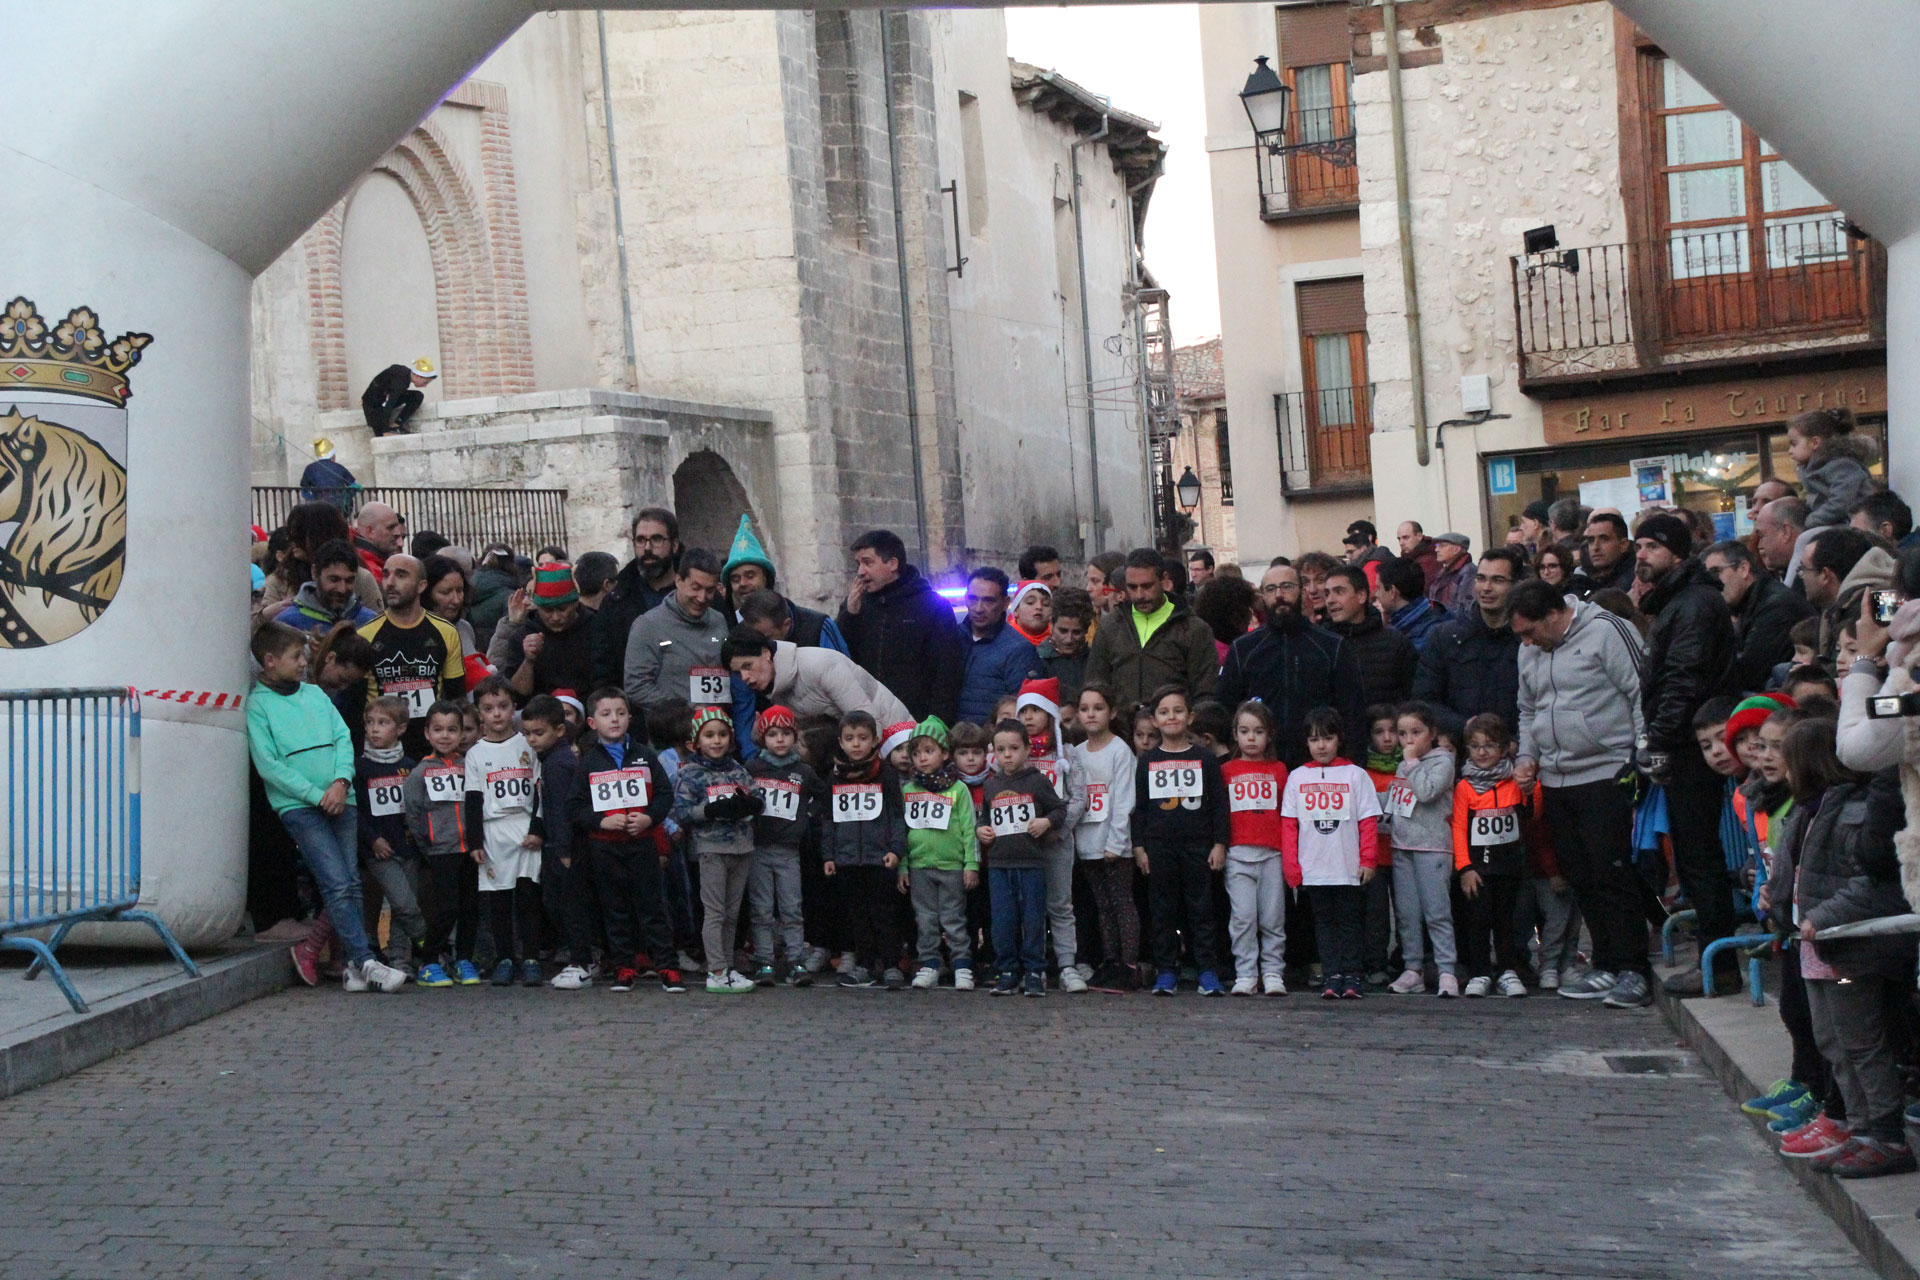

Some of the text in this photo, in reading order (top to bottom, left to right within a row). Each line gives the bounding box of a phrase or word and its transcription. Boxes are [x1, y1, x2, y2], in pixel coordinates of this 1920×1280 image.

[1576, 382, 1867, 433] Bar La Taurina
[1495, 464, 1511, 488] B
[701, 676, 723, 694] 53
[431, 774, 466, 792] 817
[494, 778, 531, 799] 806
[1155, 769, 1196, 788] 819
[598, 779, 640, 801] 816
[1234, 781, 1272, 801] 908
[838, 792, 877, 812] 815
[1305, 791, 1344, 811] 909
[993, 803, 1031, 826] 813
[1477, 814, 1514, 835] 809
